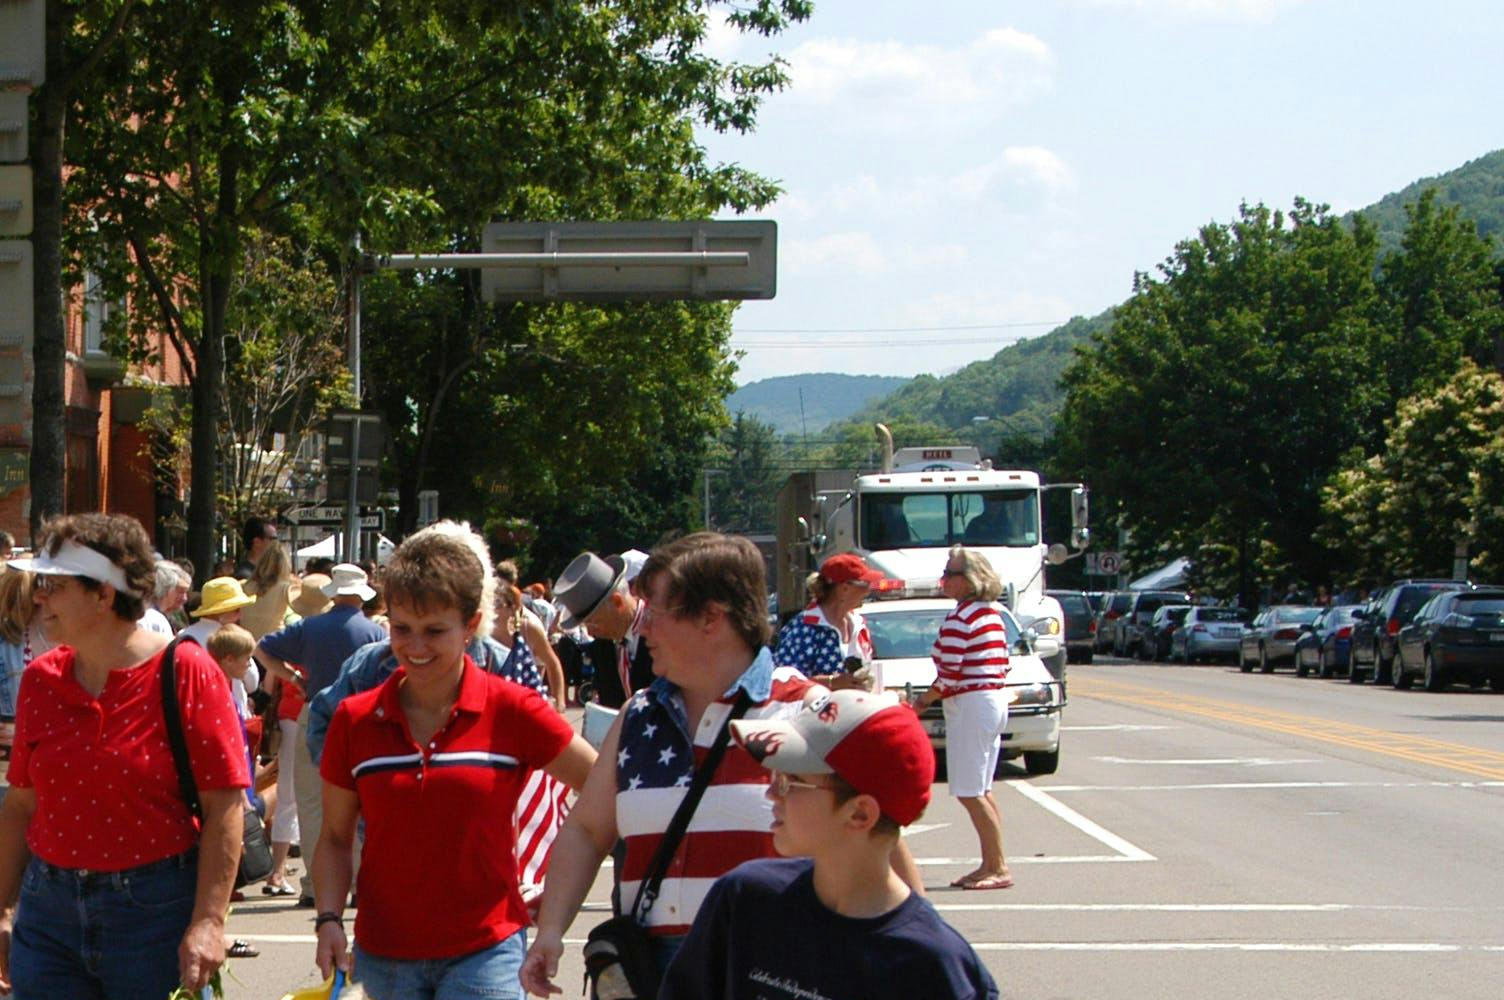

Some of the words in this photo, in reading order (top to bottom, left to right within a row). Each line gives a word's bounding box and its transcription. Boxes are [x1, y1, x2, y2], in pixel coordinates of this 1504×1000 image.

[4, 464, 24, 481] Inn
[299, 508, 317, 518] ONE
[324, 507, 342, 518] WAY
